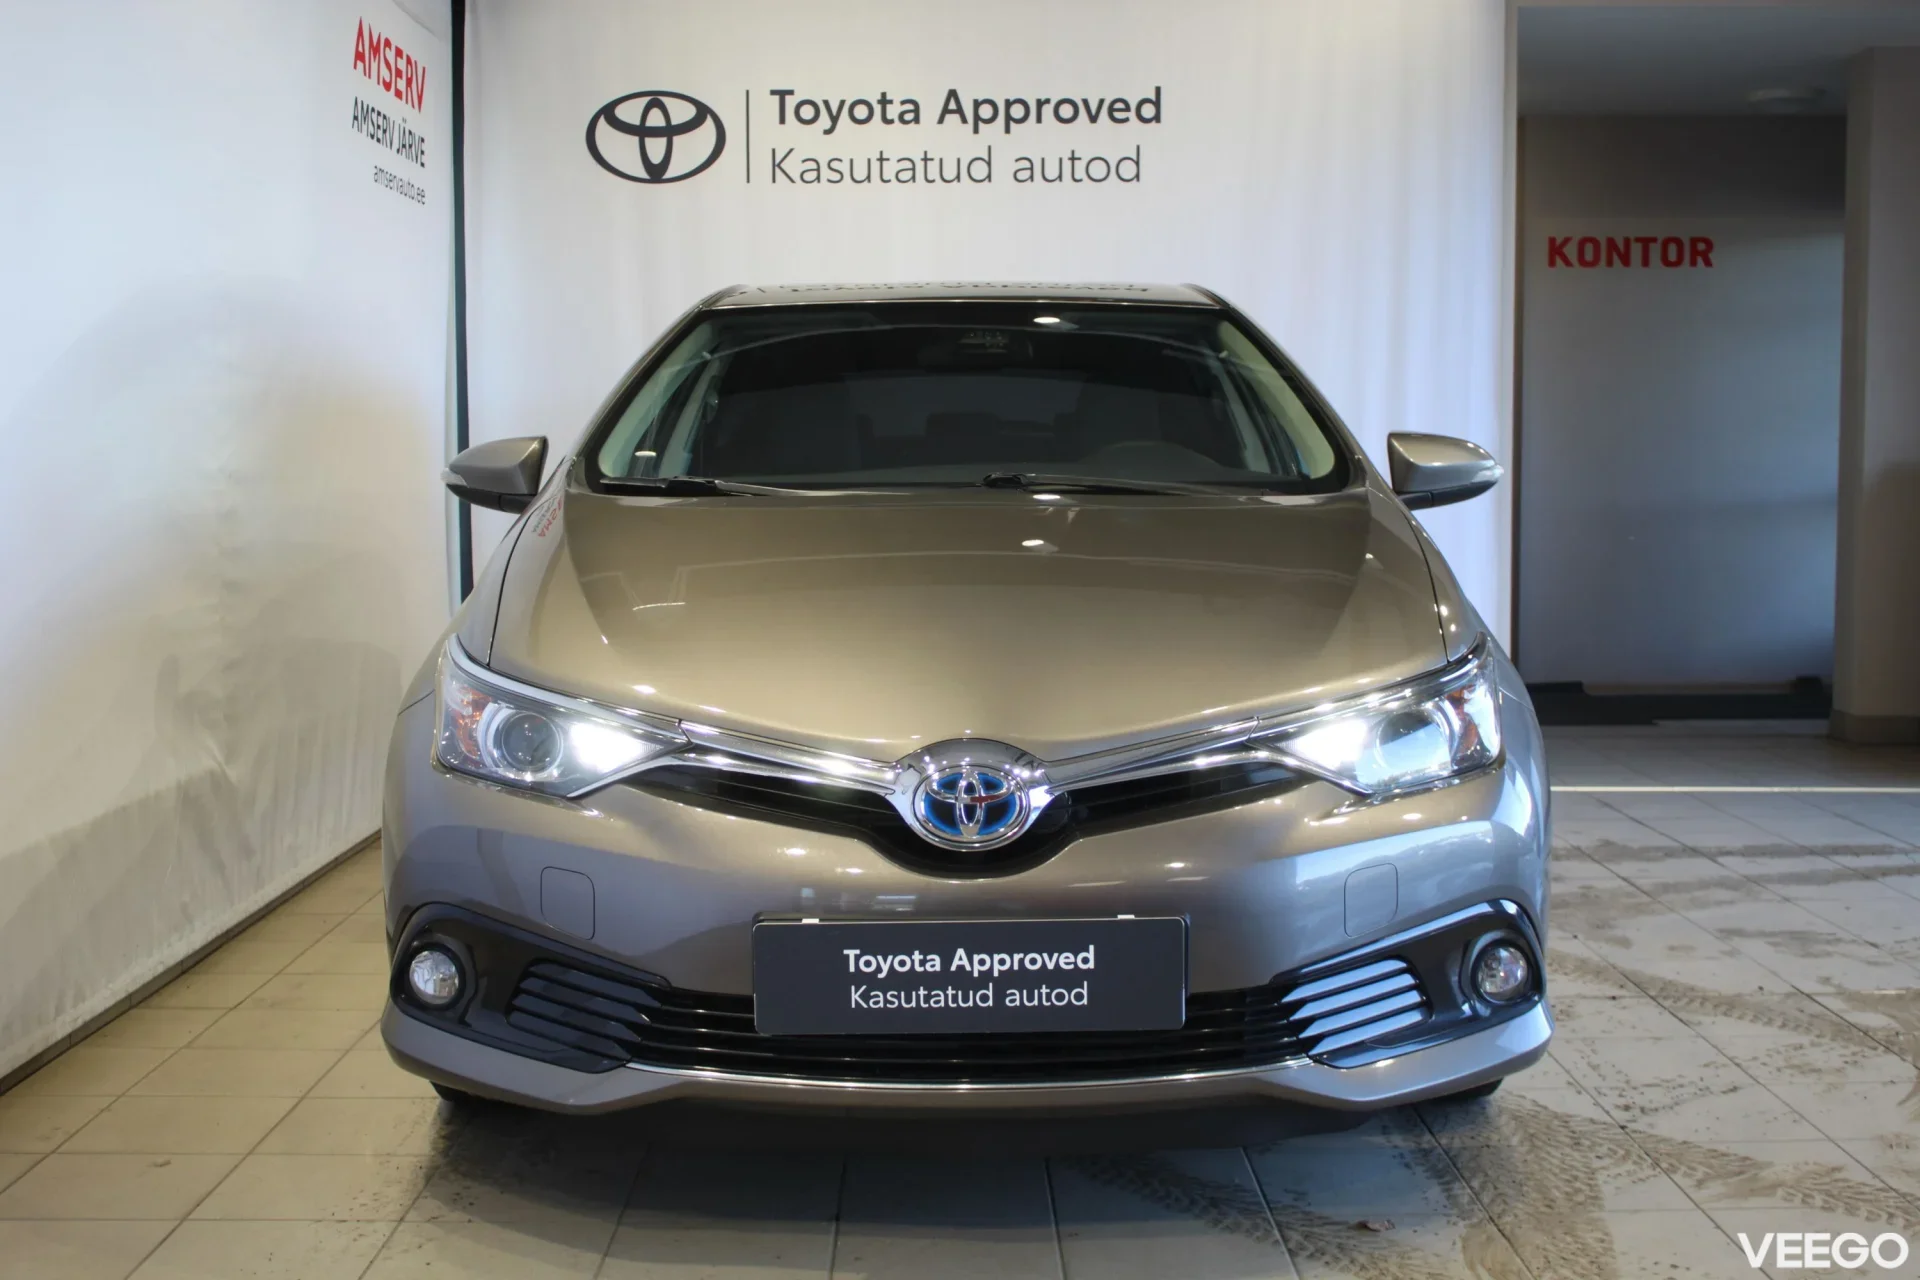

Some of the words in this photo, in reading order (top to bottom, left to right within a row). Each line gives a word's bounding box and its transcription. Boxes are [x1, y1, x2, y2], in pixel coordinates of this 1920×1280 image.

[353, 16, 426, 114] AMSERV
[769, 89, 921, 135] Toyota
[936, 86, 1162, 135] Approved
[351, 96, 395, 151] AMSERV
[396, 117, 425, 168] JÄRVE
[373, 164, 426, 205] amservauto.ee
[771, 145, 993, 184] Kasutatud
[1012, 145, 1141, 183] autod
[1548, 236, 1714, 268] KONTOR
[843, 949, 941, 978] Toyota
[950, 945, 1095, 976] Approved
[850, 983, 993, 1009] Kasutatud
[1005, 981, 1089, 1007] autod
